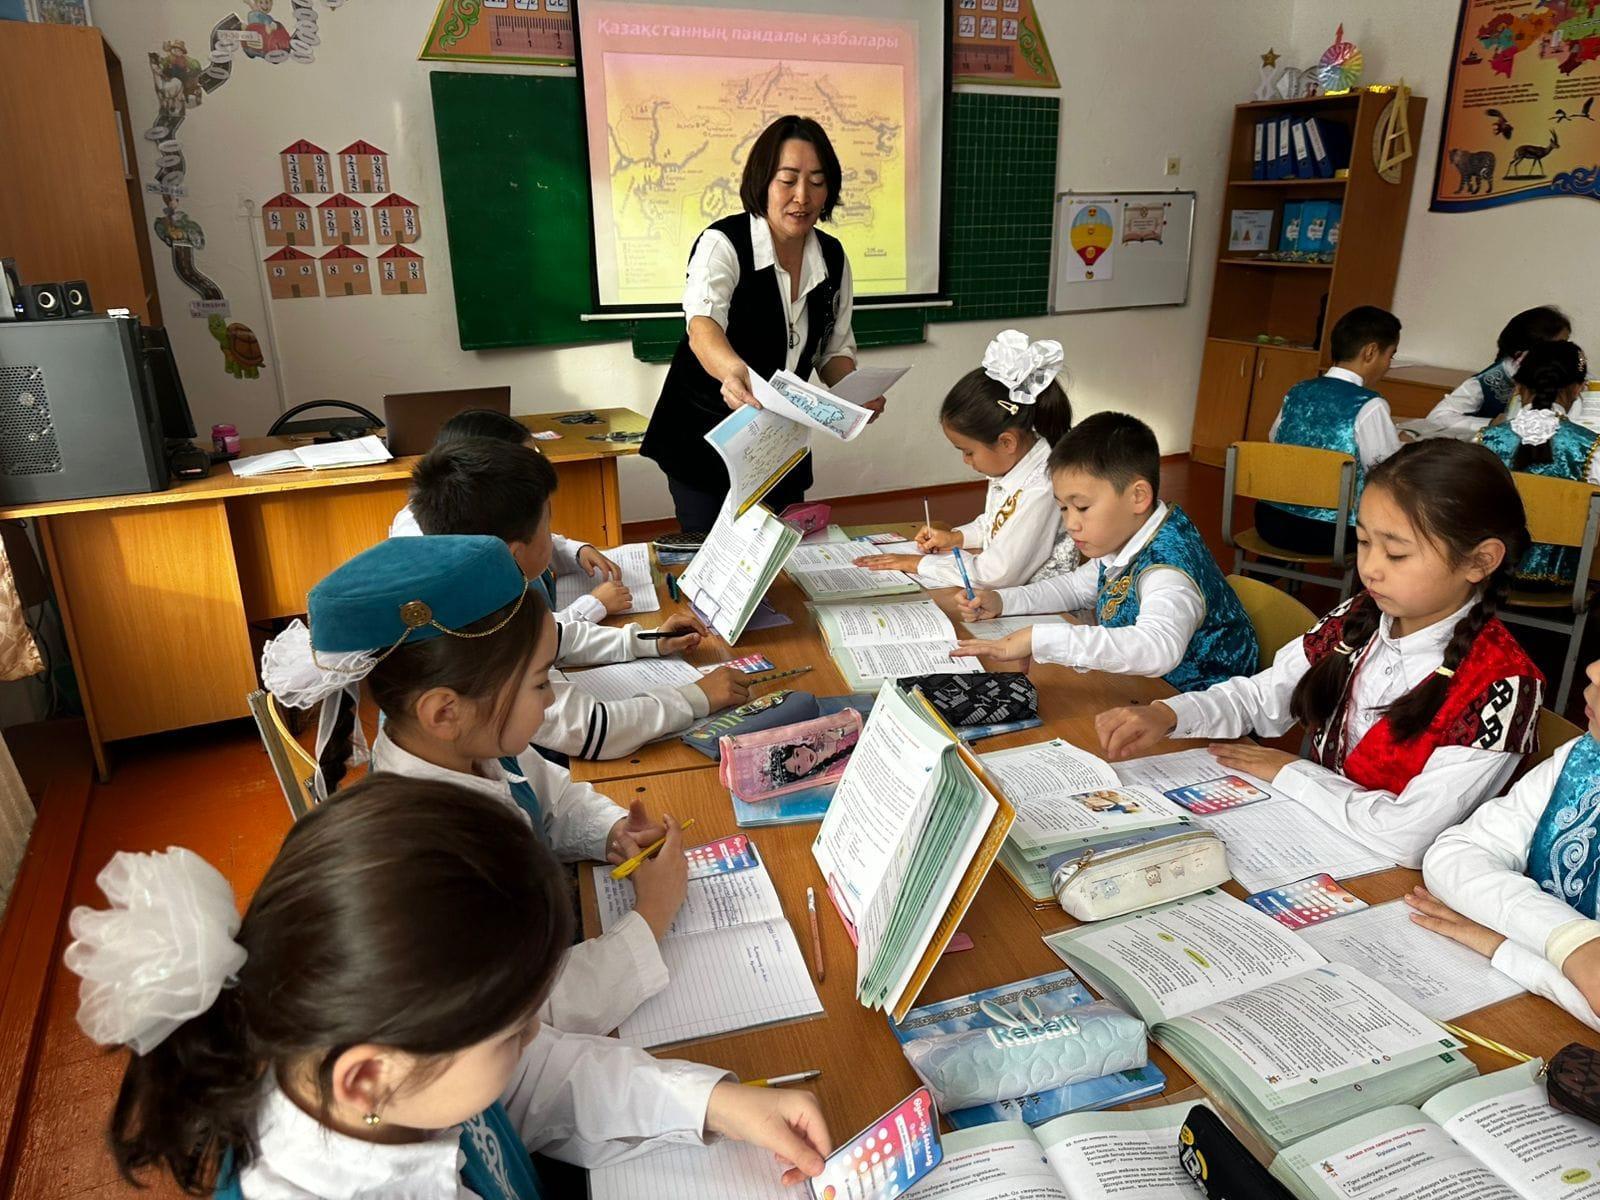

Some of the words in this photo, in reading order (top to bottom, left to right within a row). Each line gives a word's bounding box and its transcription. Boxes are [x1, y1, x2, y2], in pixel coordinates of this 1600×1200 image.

[496, 38, 502, 46] 0
[557, 41, 563, 49] 2
[811, 29, 899, 49] қазбалары
[297, 143, 310, 154] 12
[356, 143, 367, 154] 11
[283, 250, 297, 259] 18
